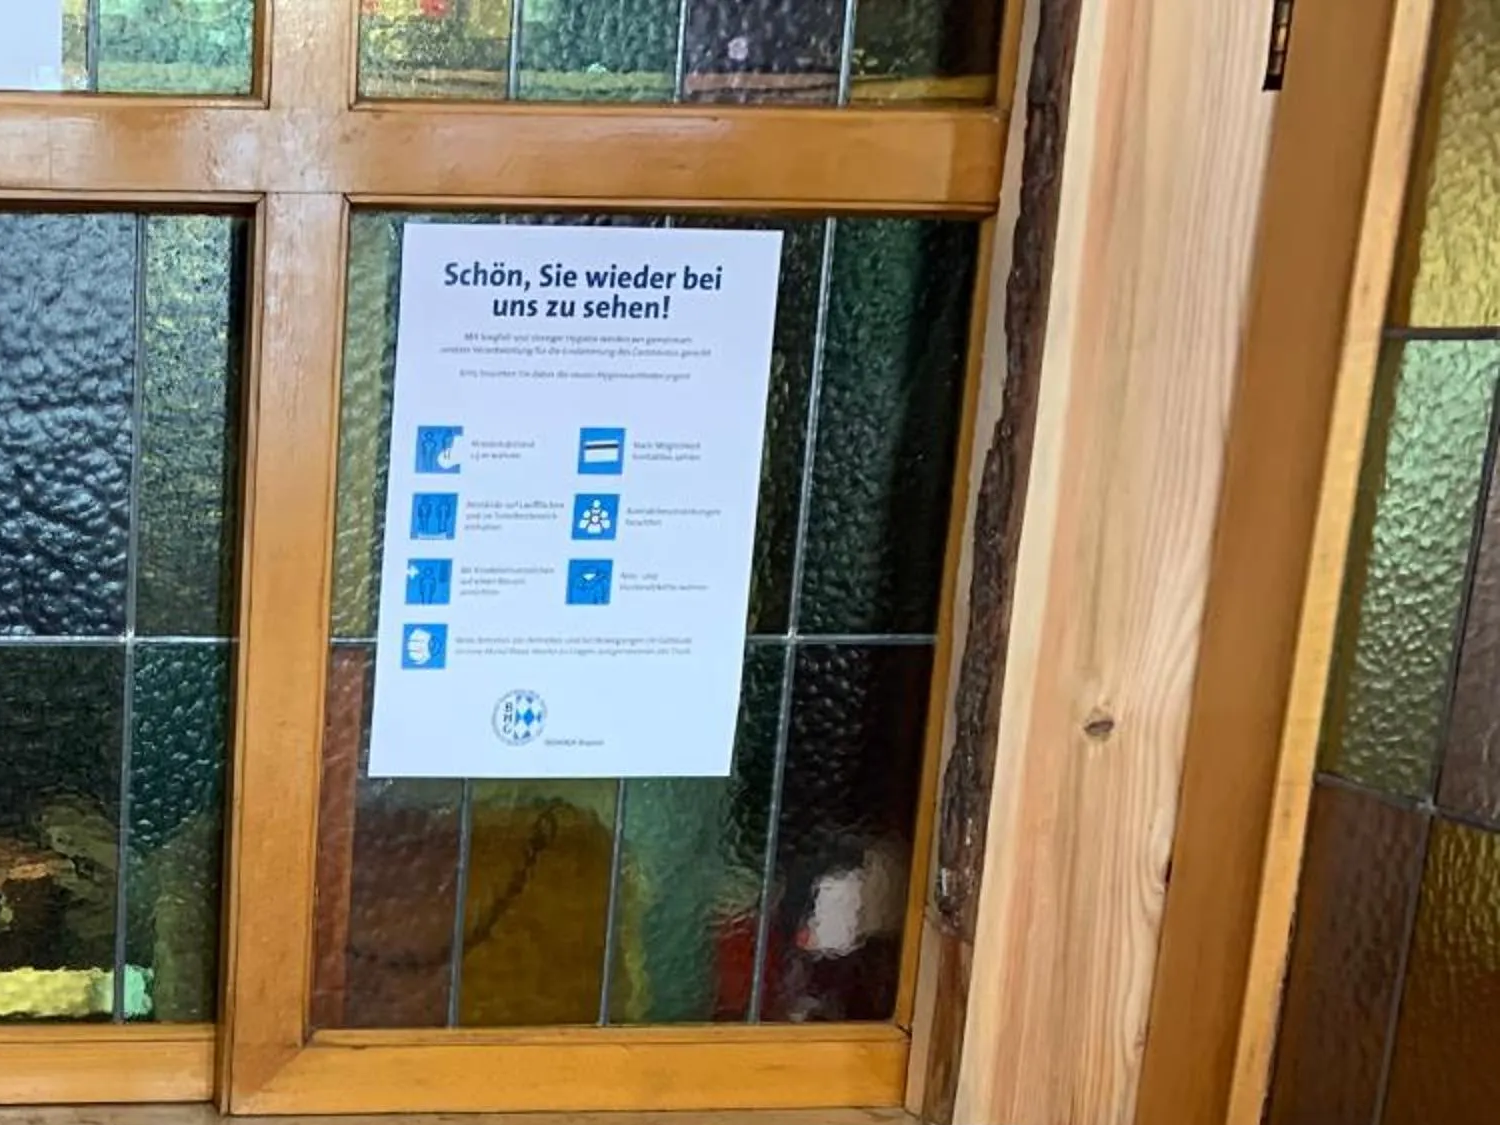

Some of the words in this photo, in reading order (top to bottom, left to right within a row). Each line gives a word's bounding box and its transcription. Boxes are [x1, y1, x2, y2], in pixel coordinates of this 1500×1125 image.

[444, 260, 531, 292] Schön,
[539, 262, 578, 288] Sie
[585, 264, 677, 290] wieder
[683, 265, 723, 291] bei
[493, 298, 538, 318] uns
[545, 299, 576, 318] zu
[583, 293, 671, 320] sehen!
